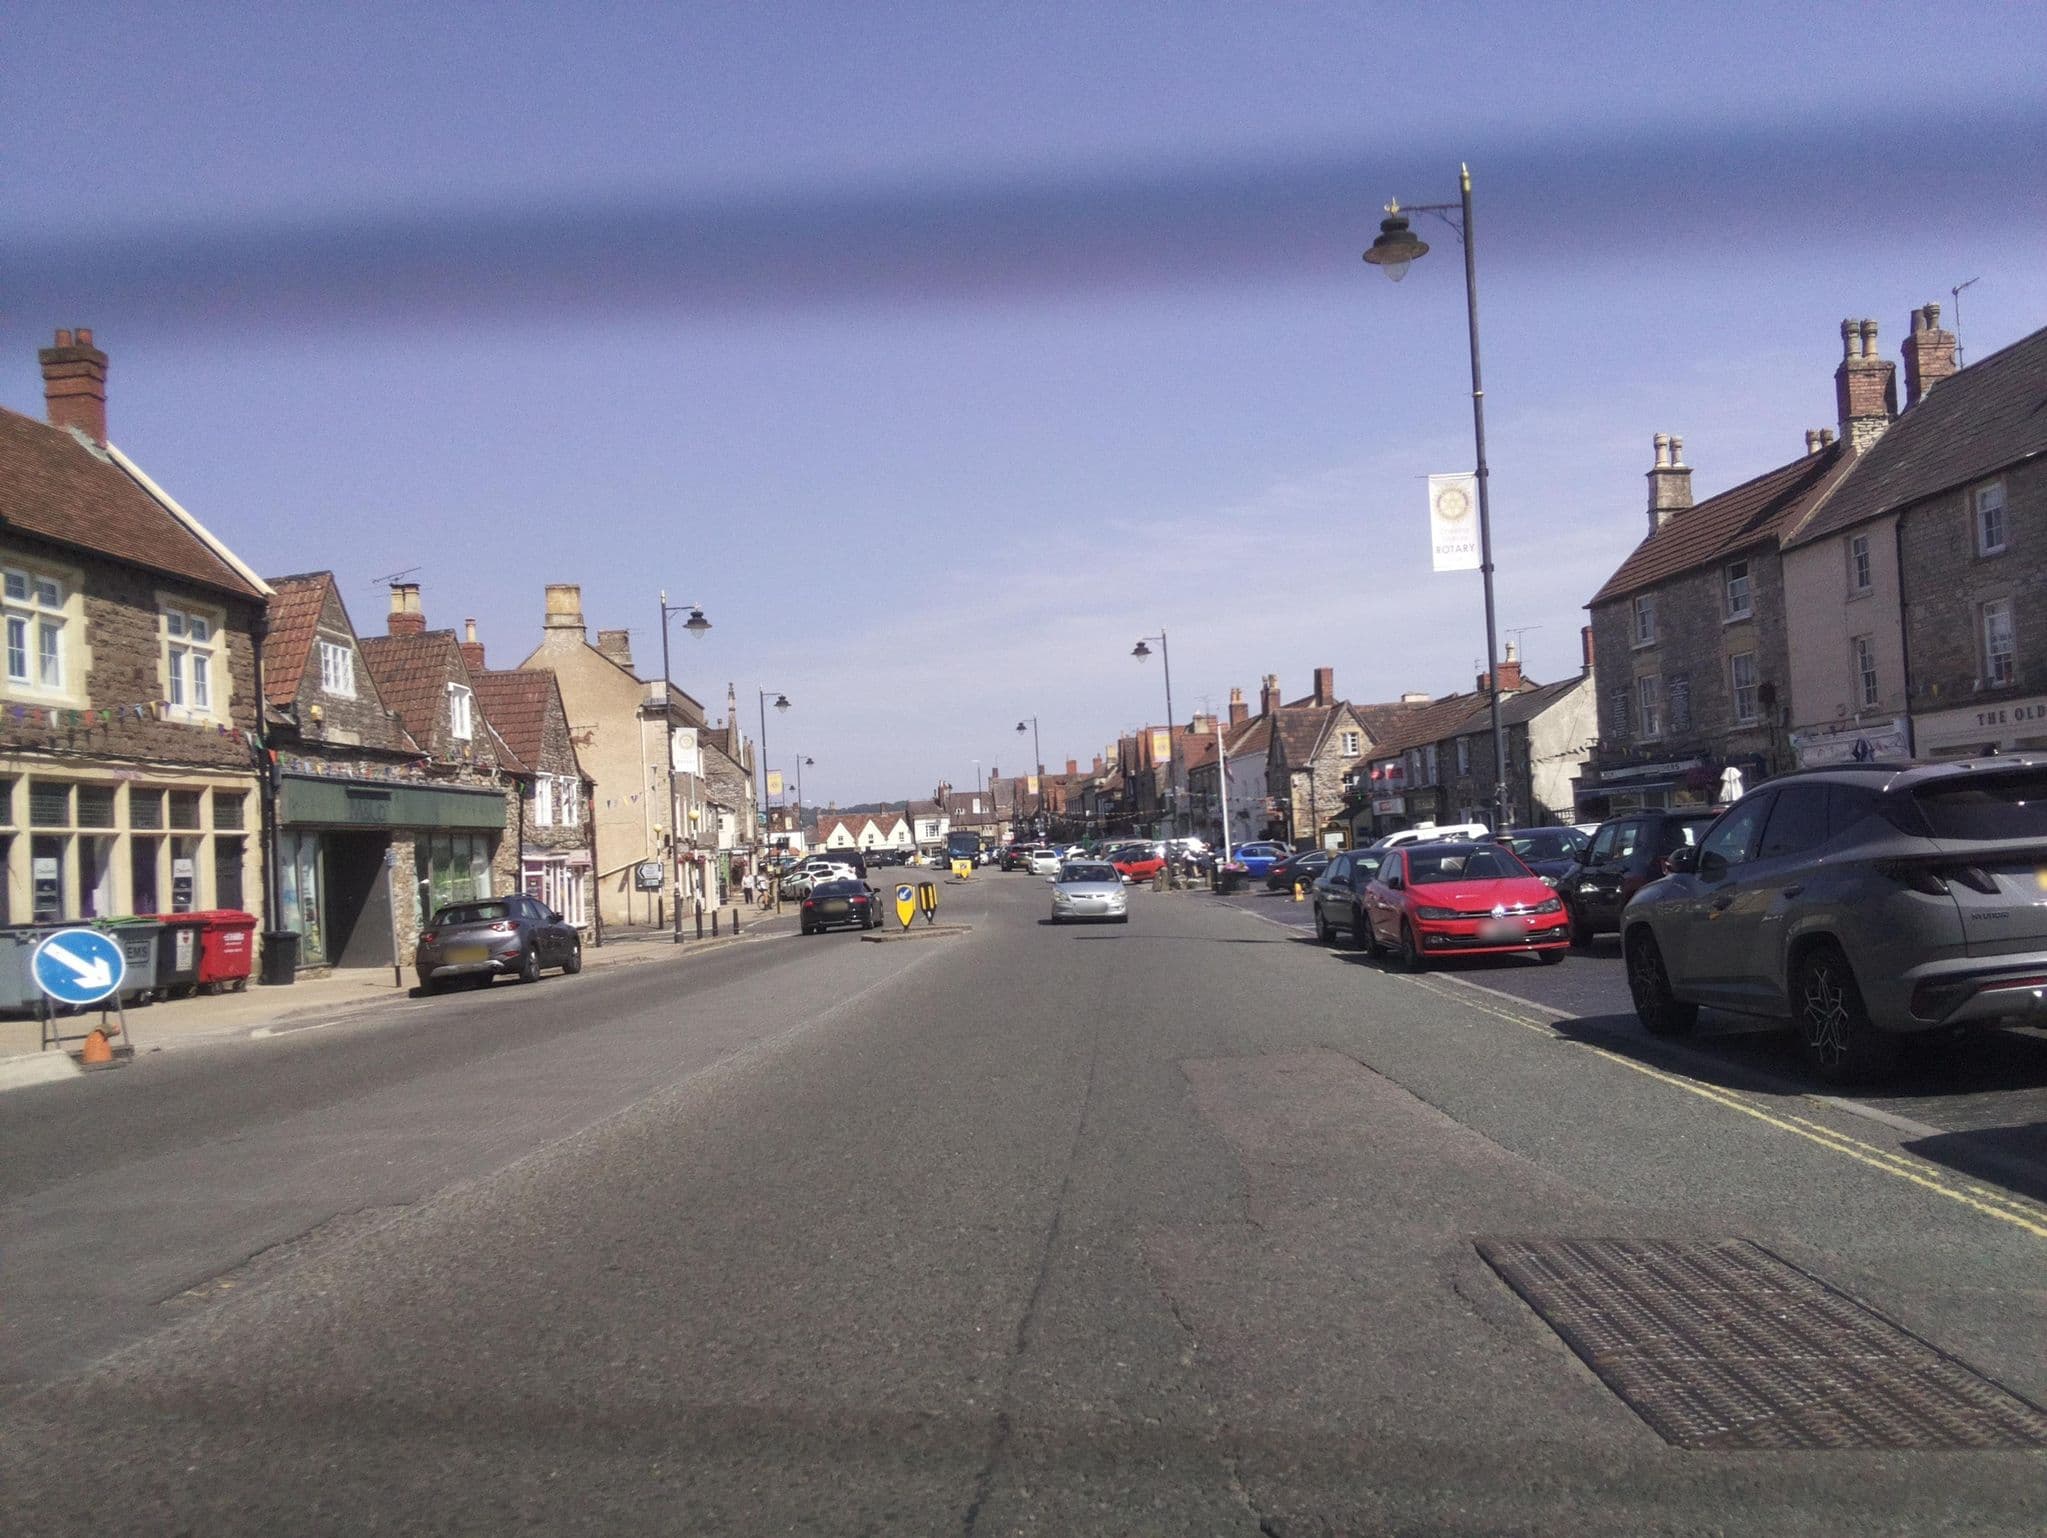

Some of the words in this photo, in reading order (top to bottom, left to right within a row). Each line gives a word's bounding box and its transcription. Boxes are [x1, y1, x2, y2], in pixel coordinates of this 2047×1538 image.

[1435, 543, 1475, 554] ROTARY
[1977, 711, 2007, 726] THE
[2015, 705, 2046, 721] OLD
[127, 946, 148, 959] EMS
